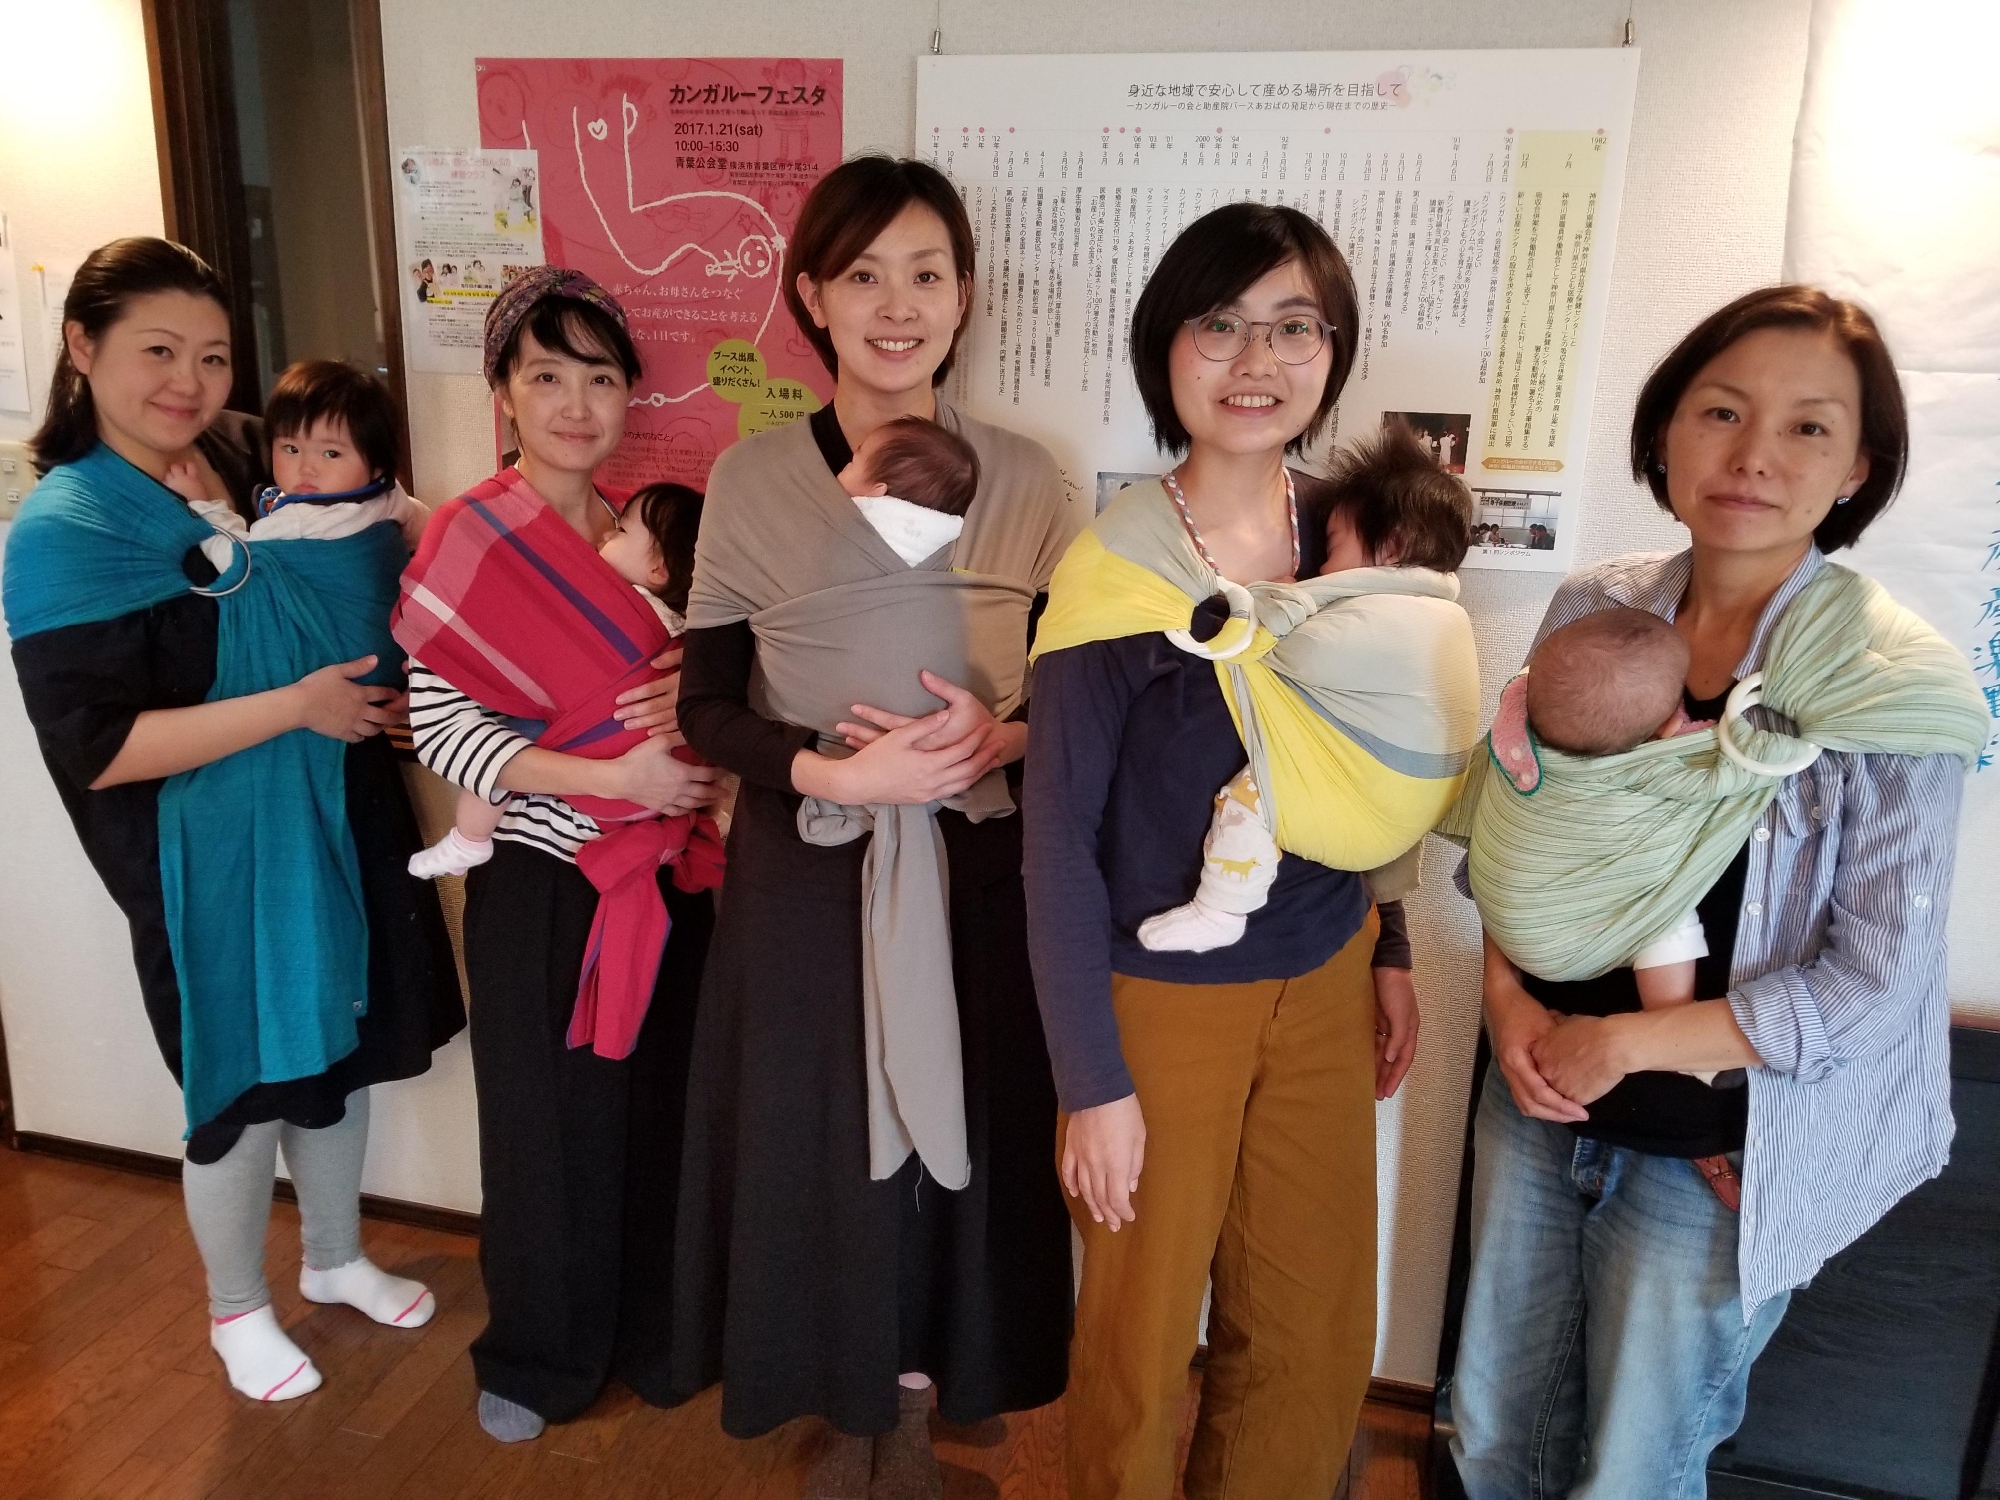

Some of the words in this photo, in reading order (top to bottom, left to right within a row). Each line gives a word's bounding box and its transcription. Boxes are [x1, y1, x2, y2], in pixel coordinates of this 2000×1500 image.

[669, 84, 826, 106] カンガルーフェスタ
[1127, 83, 1402, 98] 身近な地域で安心して産める場所を目指して
[674, 122, 763, 137] 2017.1.21(sat)
[675, 156, 727, 170] 青葉公会堂
[719, 365, 753, 376] イベント、
[766, 387, 803, 401] 入場料
